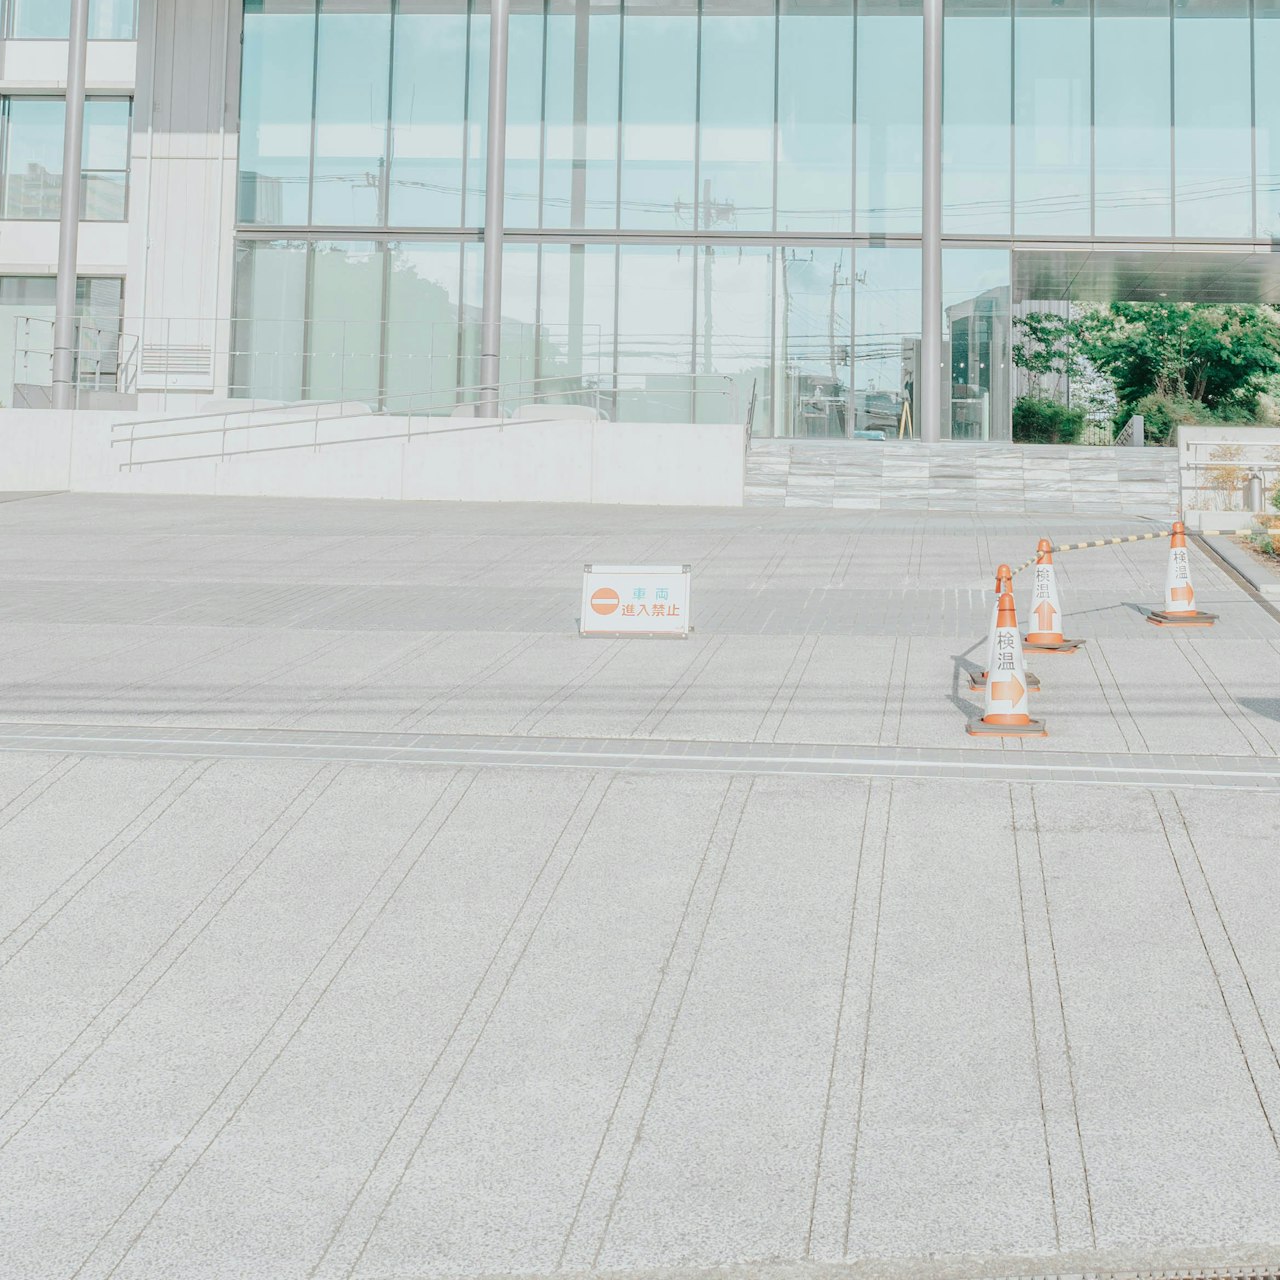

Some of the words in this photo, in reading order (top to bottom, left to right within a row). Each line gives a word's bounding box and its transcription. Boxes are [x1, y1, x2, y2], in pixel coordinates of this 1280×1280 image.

[1172, 550, 1188, 579] 検温
[1036, 567, 1051, 599] 検温
[621, 603, 680, 617] 進入禁止
[997, 631, 1016, 671] 検温
